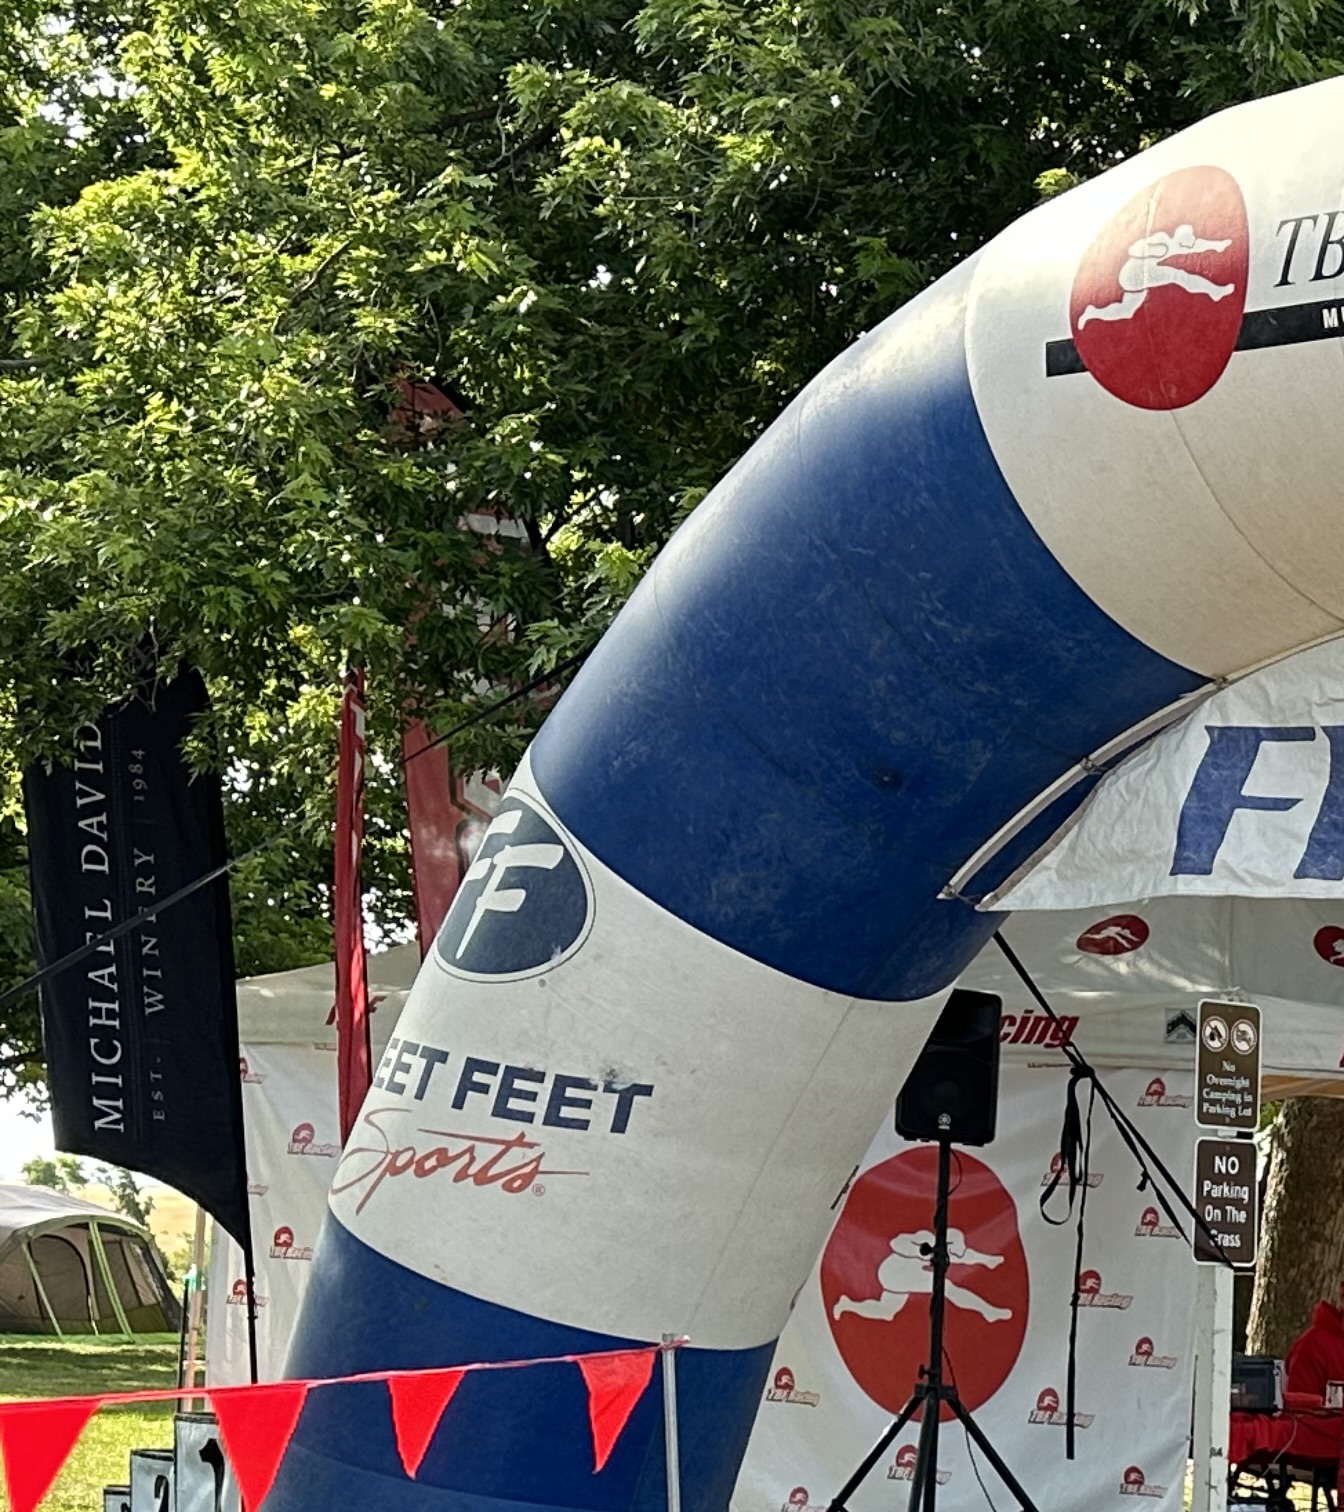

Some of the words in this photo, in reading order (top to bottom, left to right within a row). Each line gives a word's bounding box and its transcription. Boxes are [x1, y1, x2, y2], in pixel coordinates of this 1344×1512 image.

[74, 720, 111, 876] DAVID
[130, 747, 147, 801] 1984
[133, 848, 166, 1015] WINERY
[83, 898, 125, 1133] MICHAEL
[451, 1056, 654, 1134] FEET
[1202, 1102, 1236, 1118] Parking
[330, 1108, 590, 1216] Sports
[1203, 1180, 1250, 1204] Parking
[1214, 1156, 1240, 1175] NO
[1204, 1204, 1222, 1222] On
[1225, 1206, 1247, 1223] The
